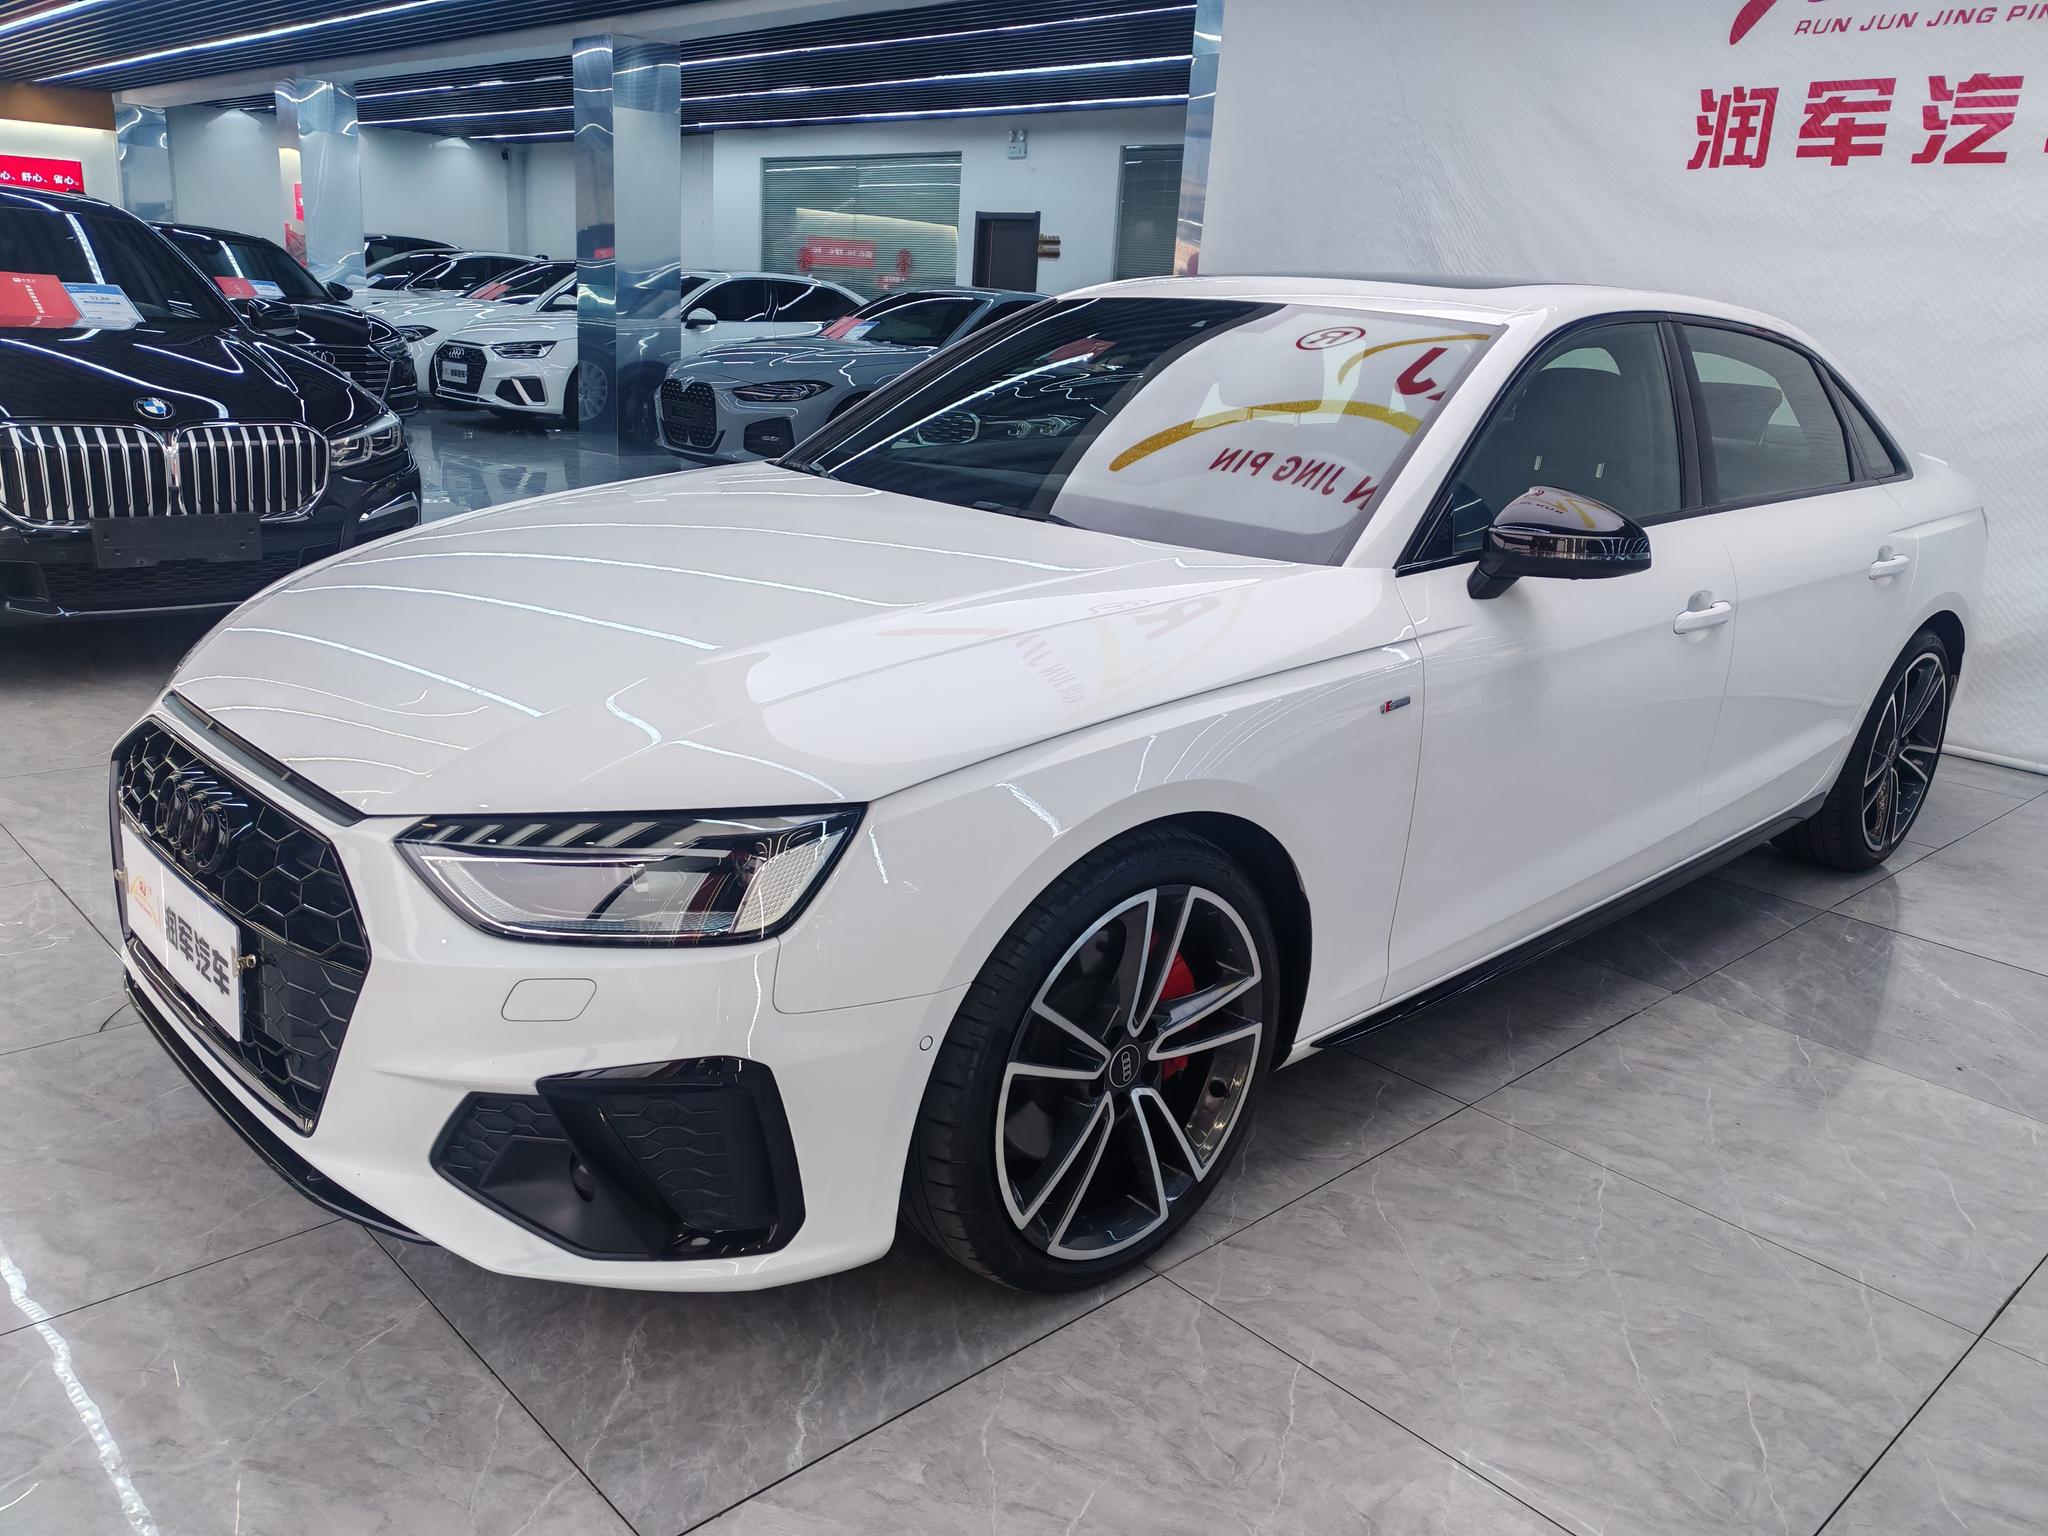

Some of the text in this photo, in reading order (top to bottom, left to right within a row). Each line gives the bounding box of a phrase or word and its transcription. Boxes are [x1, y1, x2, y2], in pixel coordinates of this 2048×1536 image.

[1793, 16, 1853, 36] RUN
[1859, 11, 1919, 32] JUN
[1926, 7, 1998, 27] JING
[1686, 73, 2048, 170] 润军汽
[165, 904, 231, 996] 润军汽车
